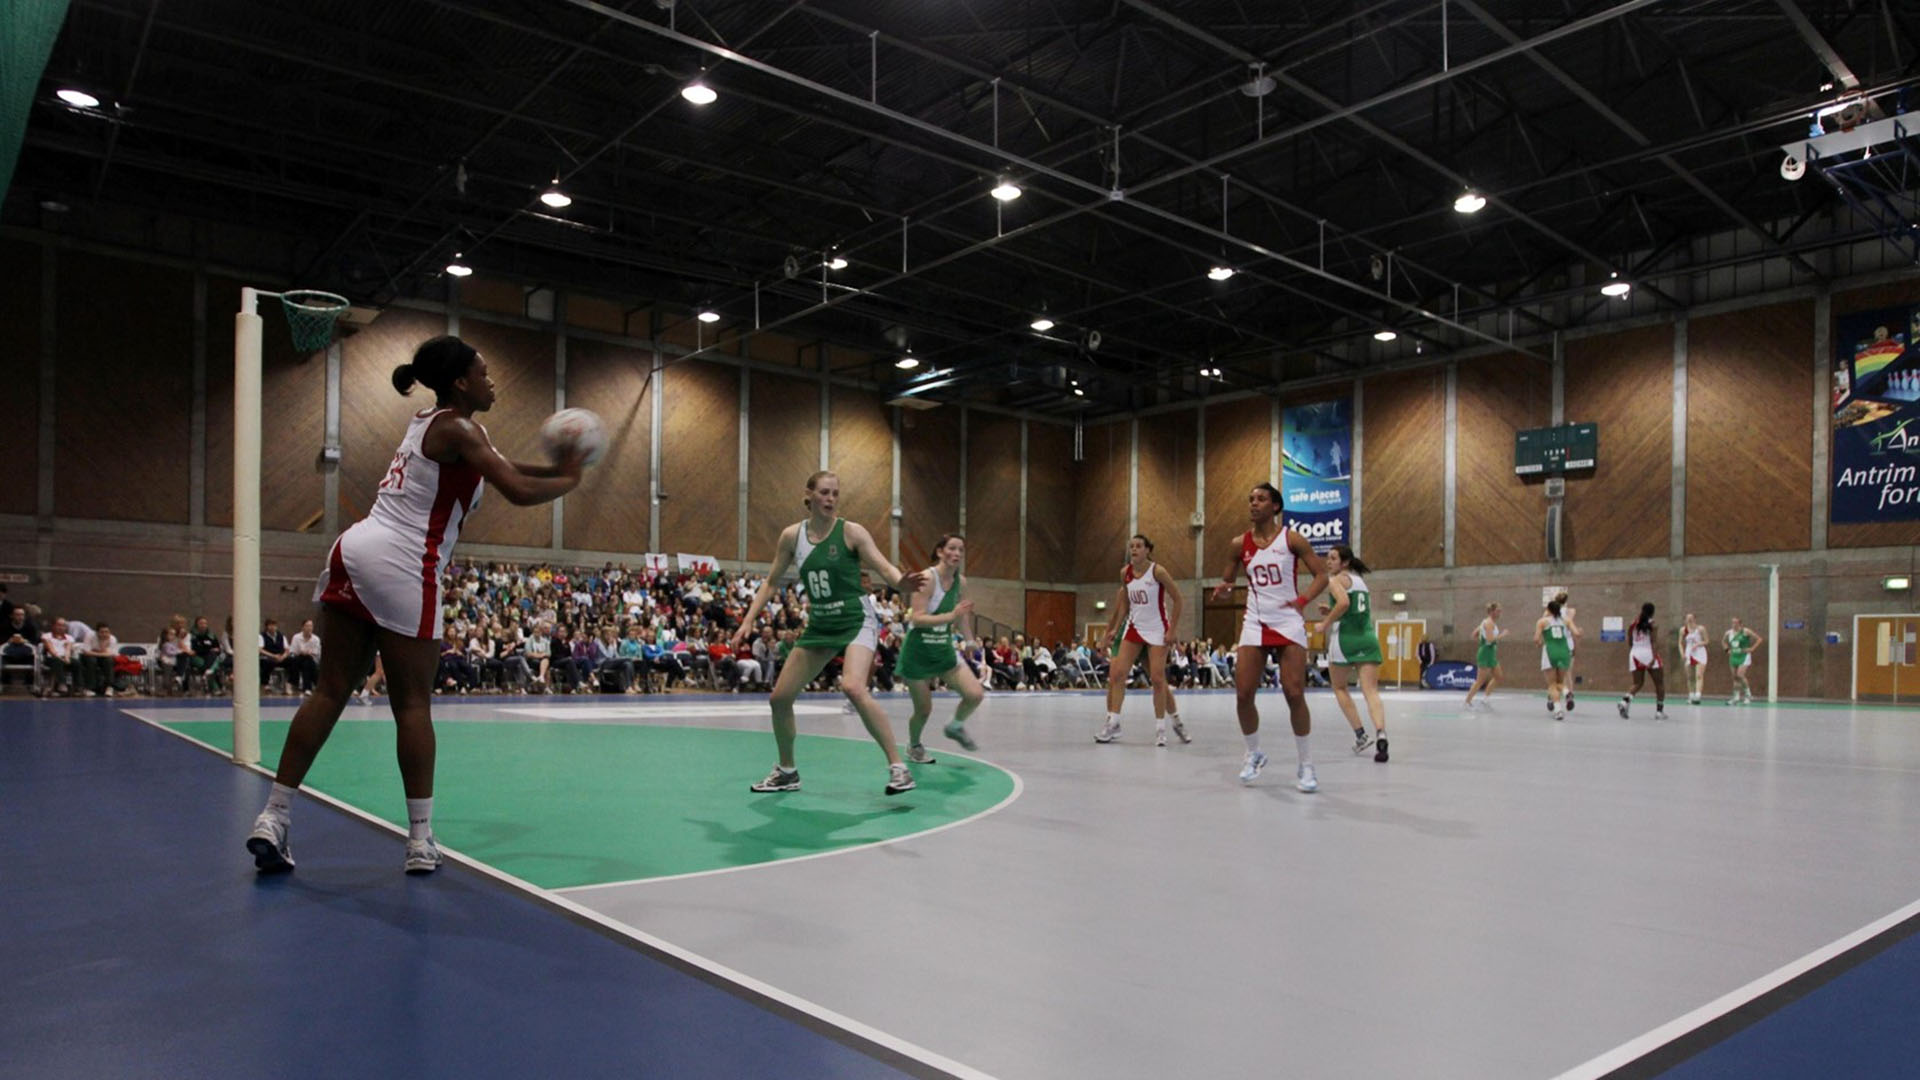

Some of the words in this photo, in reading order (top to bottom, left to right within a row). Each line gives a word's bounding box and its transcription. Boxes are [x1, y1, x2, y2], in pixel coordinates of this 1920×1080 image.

[1837, 463, 1916, 487] Antrim
[1310, 489, 1340, 502] places
[808, 569, 832, 599] GS
[1253, 564, 1282, 587] GD
[1357, 592, 1366, 612] C
